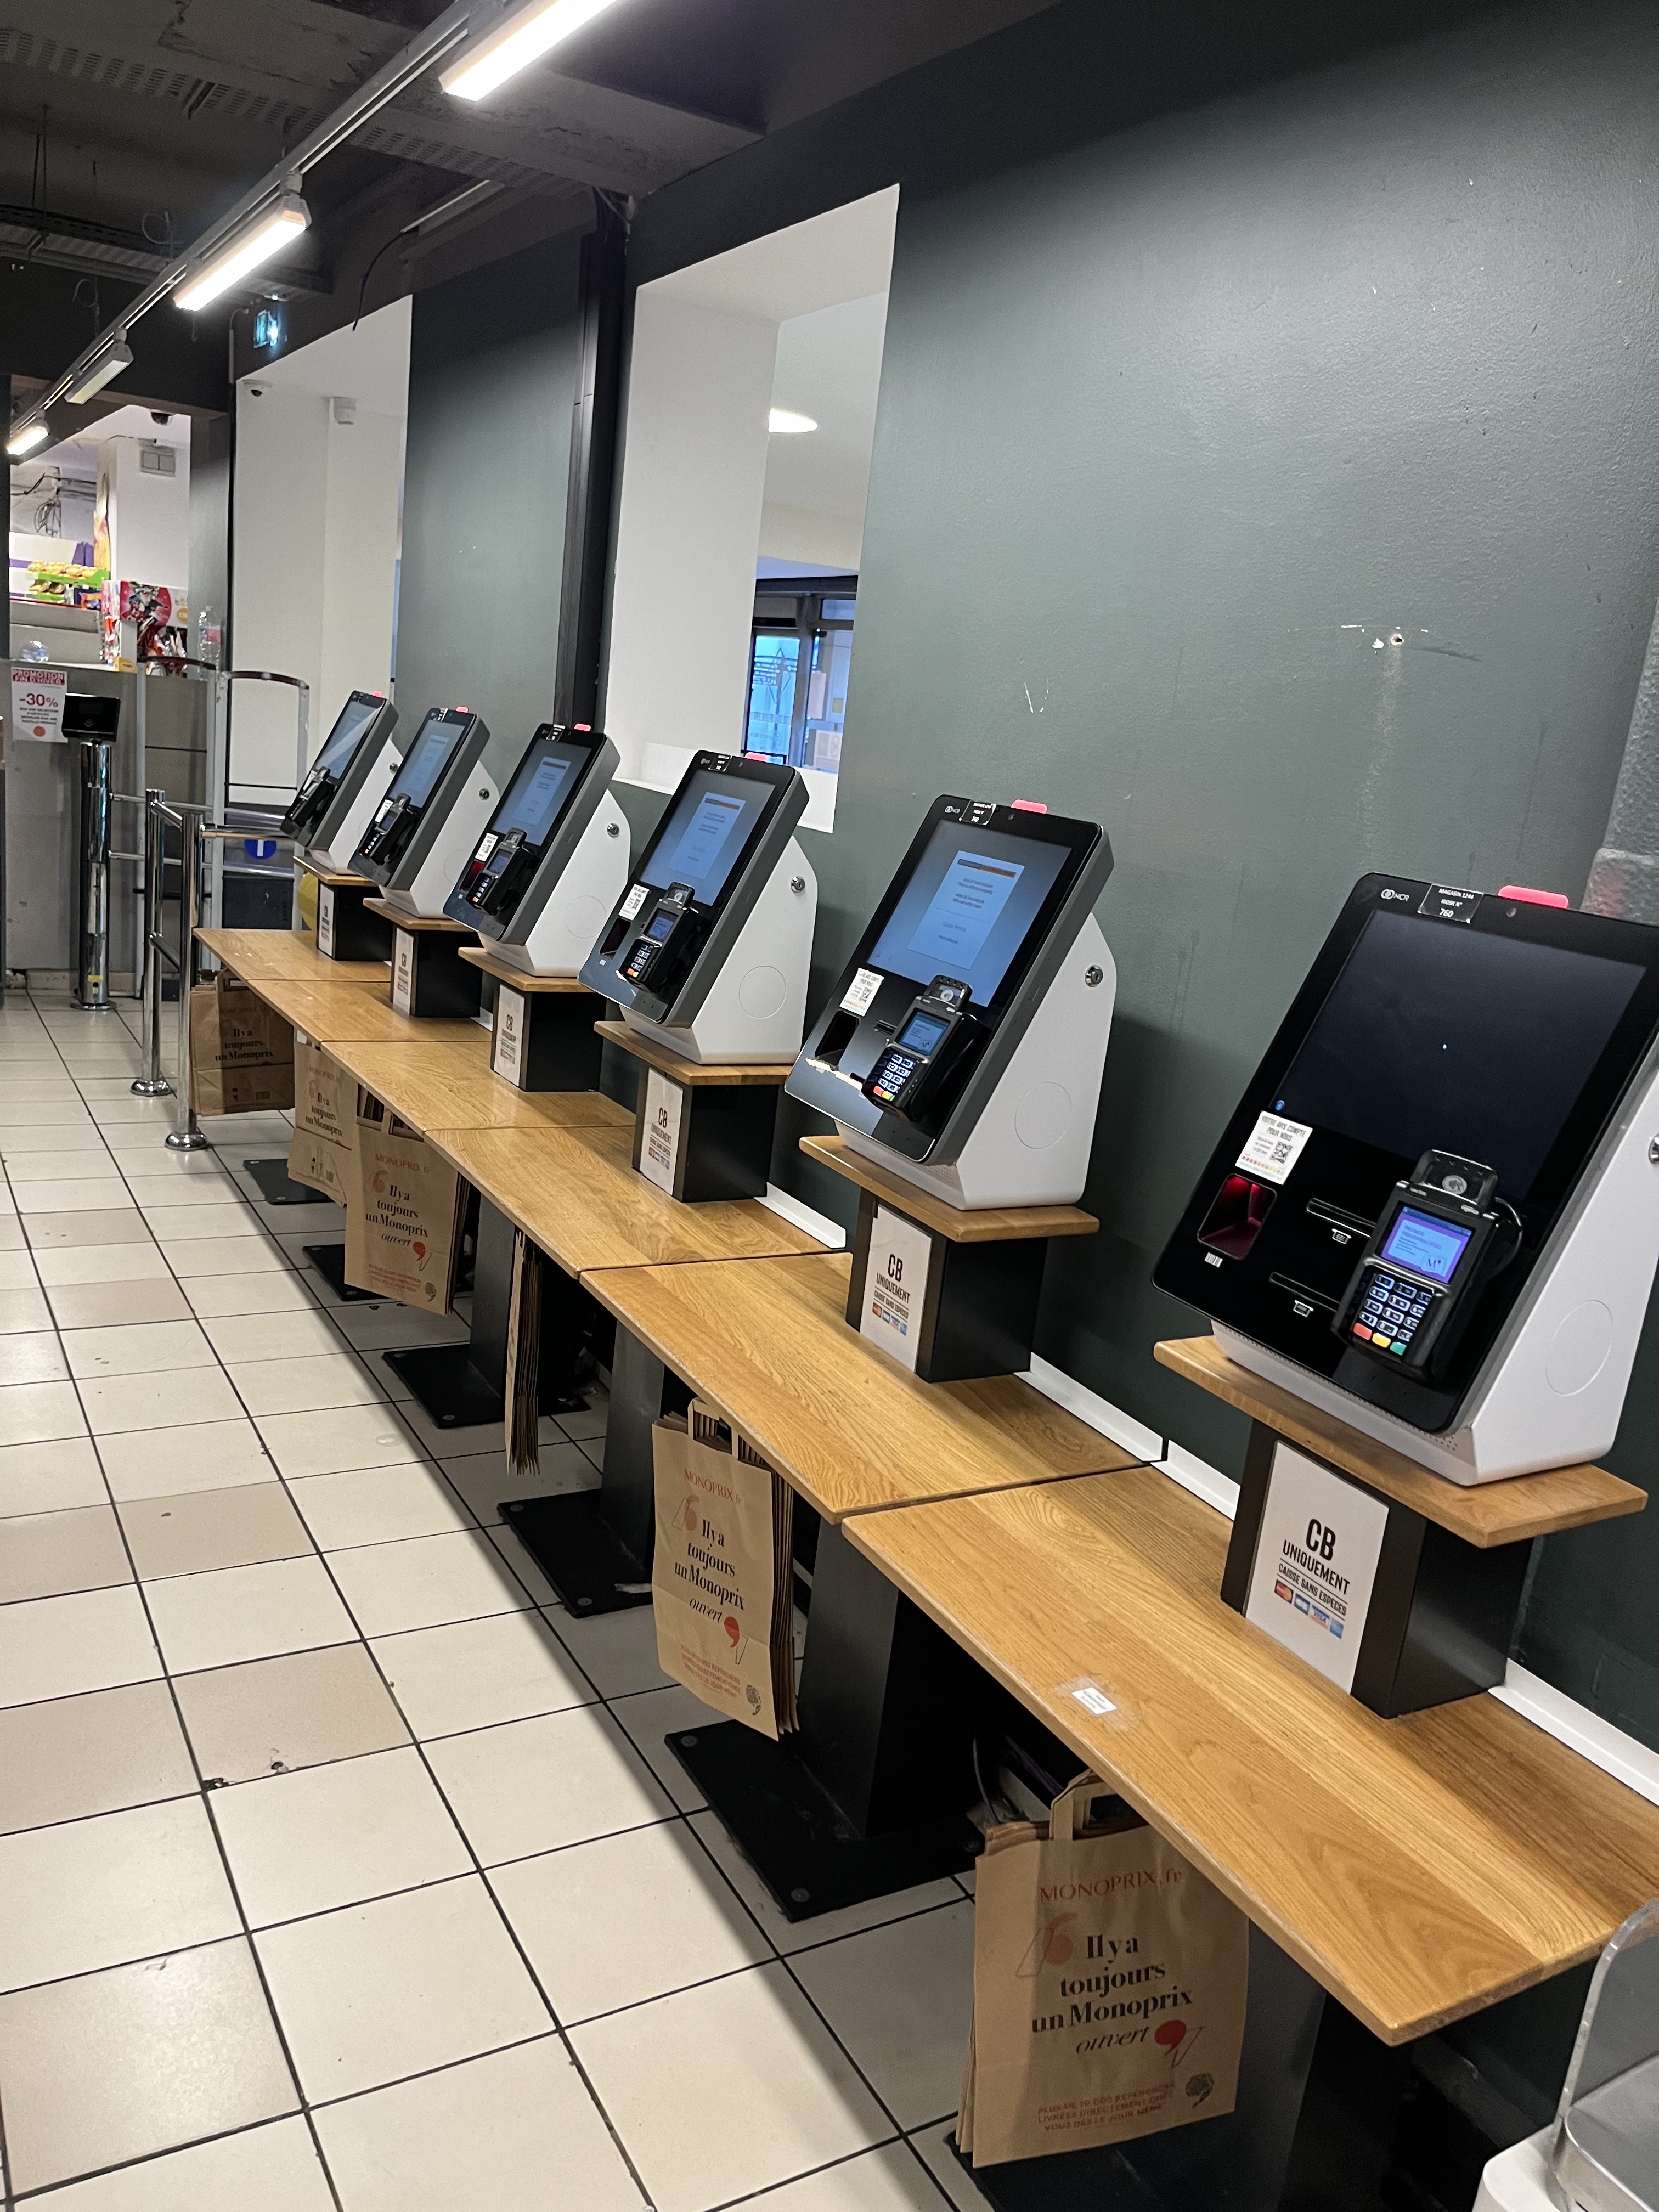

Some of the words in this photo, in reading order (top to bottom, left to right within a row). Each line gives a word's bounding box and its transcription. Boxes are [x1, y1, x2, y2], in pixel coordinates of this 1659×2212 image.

[20, 693, 58, 707] -30%
[1438, 888, 1461, 897] MAGASIN
[1439, 909, 1454, 917] 760
[224, 1040, 263, 1050] toujours
[228, 1049, 273, 1060] Monoprix
[311, 1105, 336, 1121] toujours
[658, 1107, 668, 1128] CB
[306, 1116, 313, 1125] un
[314, 1116, 343, 1137] Monoprix
[377, 1200, 419, 1218] toujours
[366, 1213, 378, 1223] un
[380, 1213, 428, 1238] Monoprix
[381, 1233, 411, 1247] ouvert
[888, 1254, 903, 1282] CB
[876, 1272, 910, 1304] UNIQUEMENT
[1306, 1519, 1336, 1561] CB
[687, 1542, 735, 1577] toujours
[1283, 1539, 1350, 1595] UNIQUEMENT
[675, 1562, 687, 1580] un
[689, 1564, 744, 1611] Monoprix
[1278, 1563, 1300, 1584] CAISSE
[1301, 1578, 1318, 1596] SANS
[689, 1598, 723, 1623] ouvert
[1126, 1937, 1138, 1953] a
[1060, 1963, 1166, 1997] toujours
[1032, 2013, 1063, 2033] un
[1070, 1985, 1193, 2027] Monoprix
[1076, 2026, 1149, 2054] ouvert
